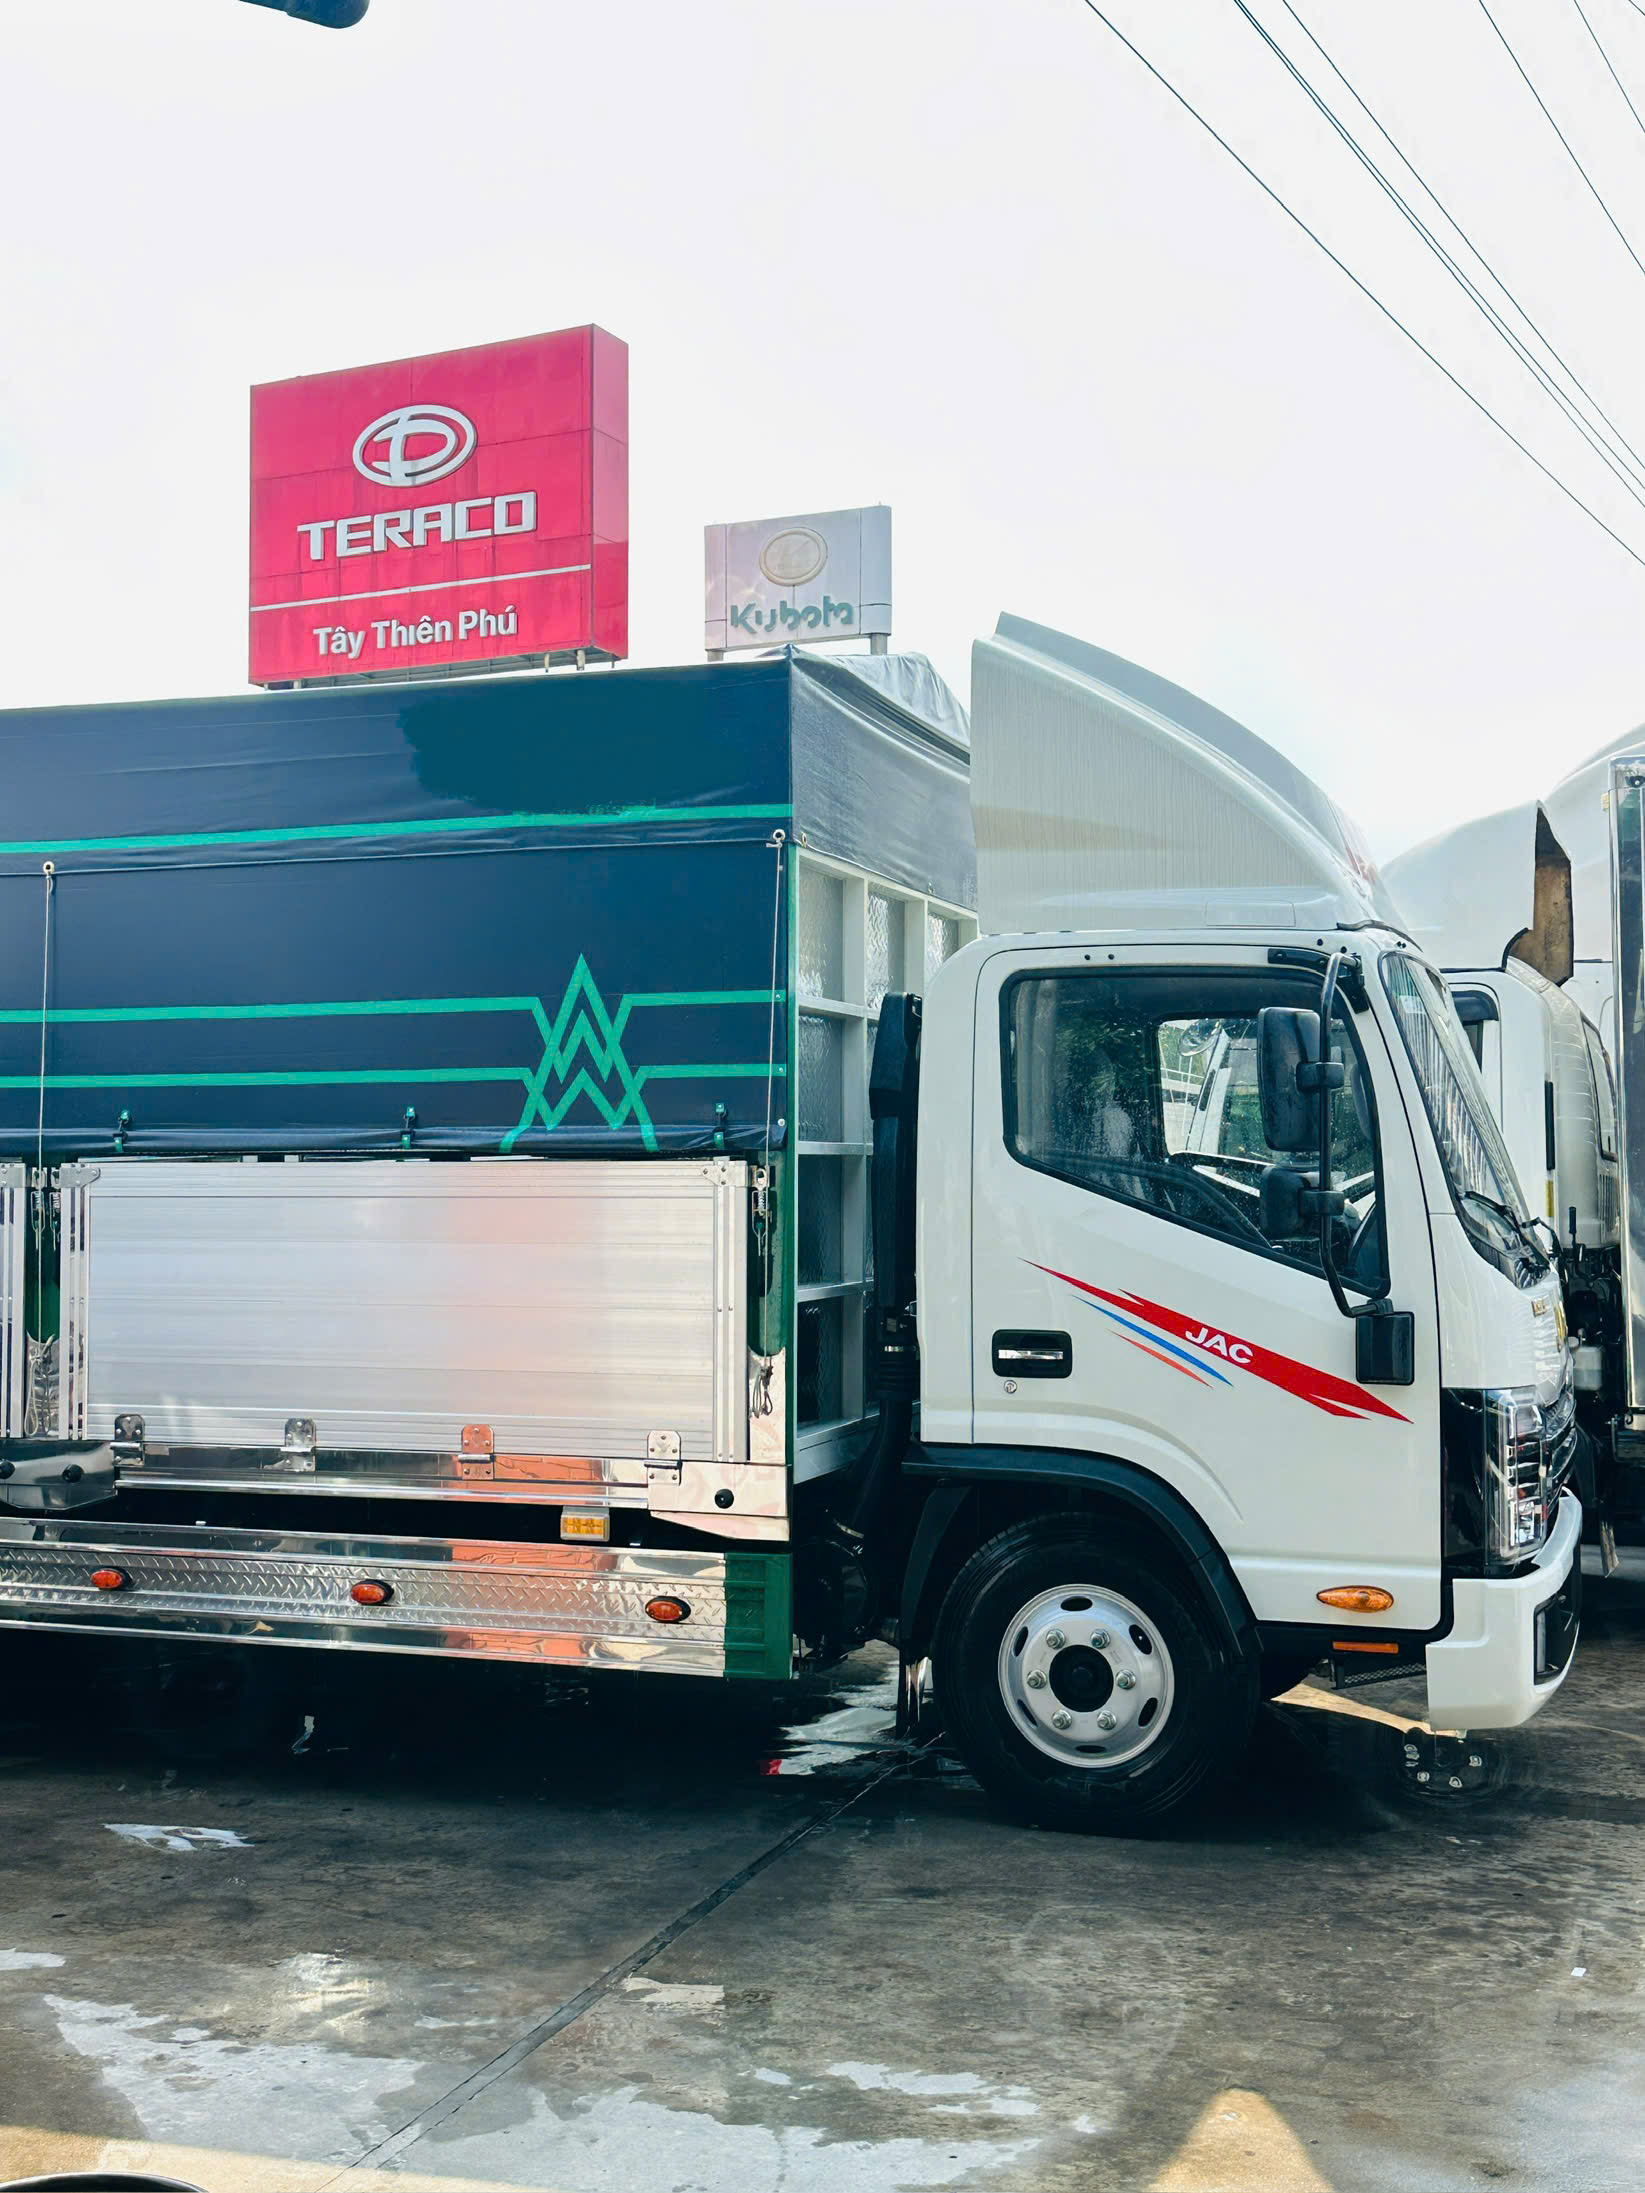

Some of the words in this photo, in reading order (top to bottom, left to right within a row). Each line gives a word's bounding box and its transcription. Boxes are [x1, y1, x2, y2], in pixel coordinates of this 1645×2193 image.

[297, 491, 537, 561] TERACO
[313, 626, 366, 660] Tây
[371, 615, 453, 649] Thiên
[458, 605, 518, 640] Phú
[1185, 1327, 1254, 1364] JAC
